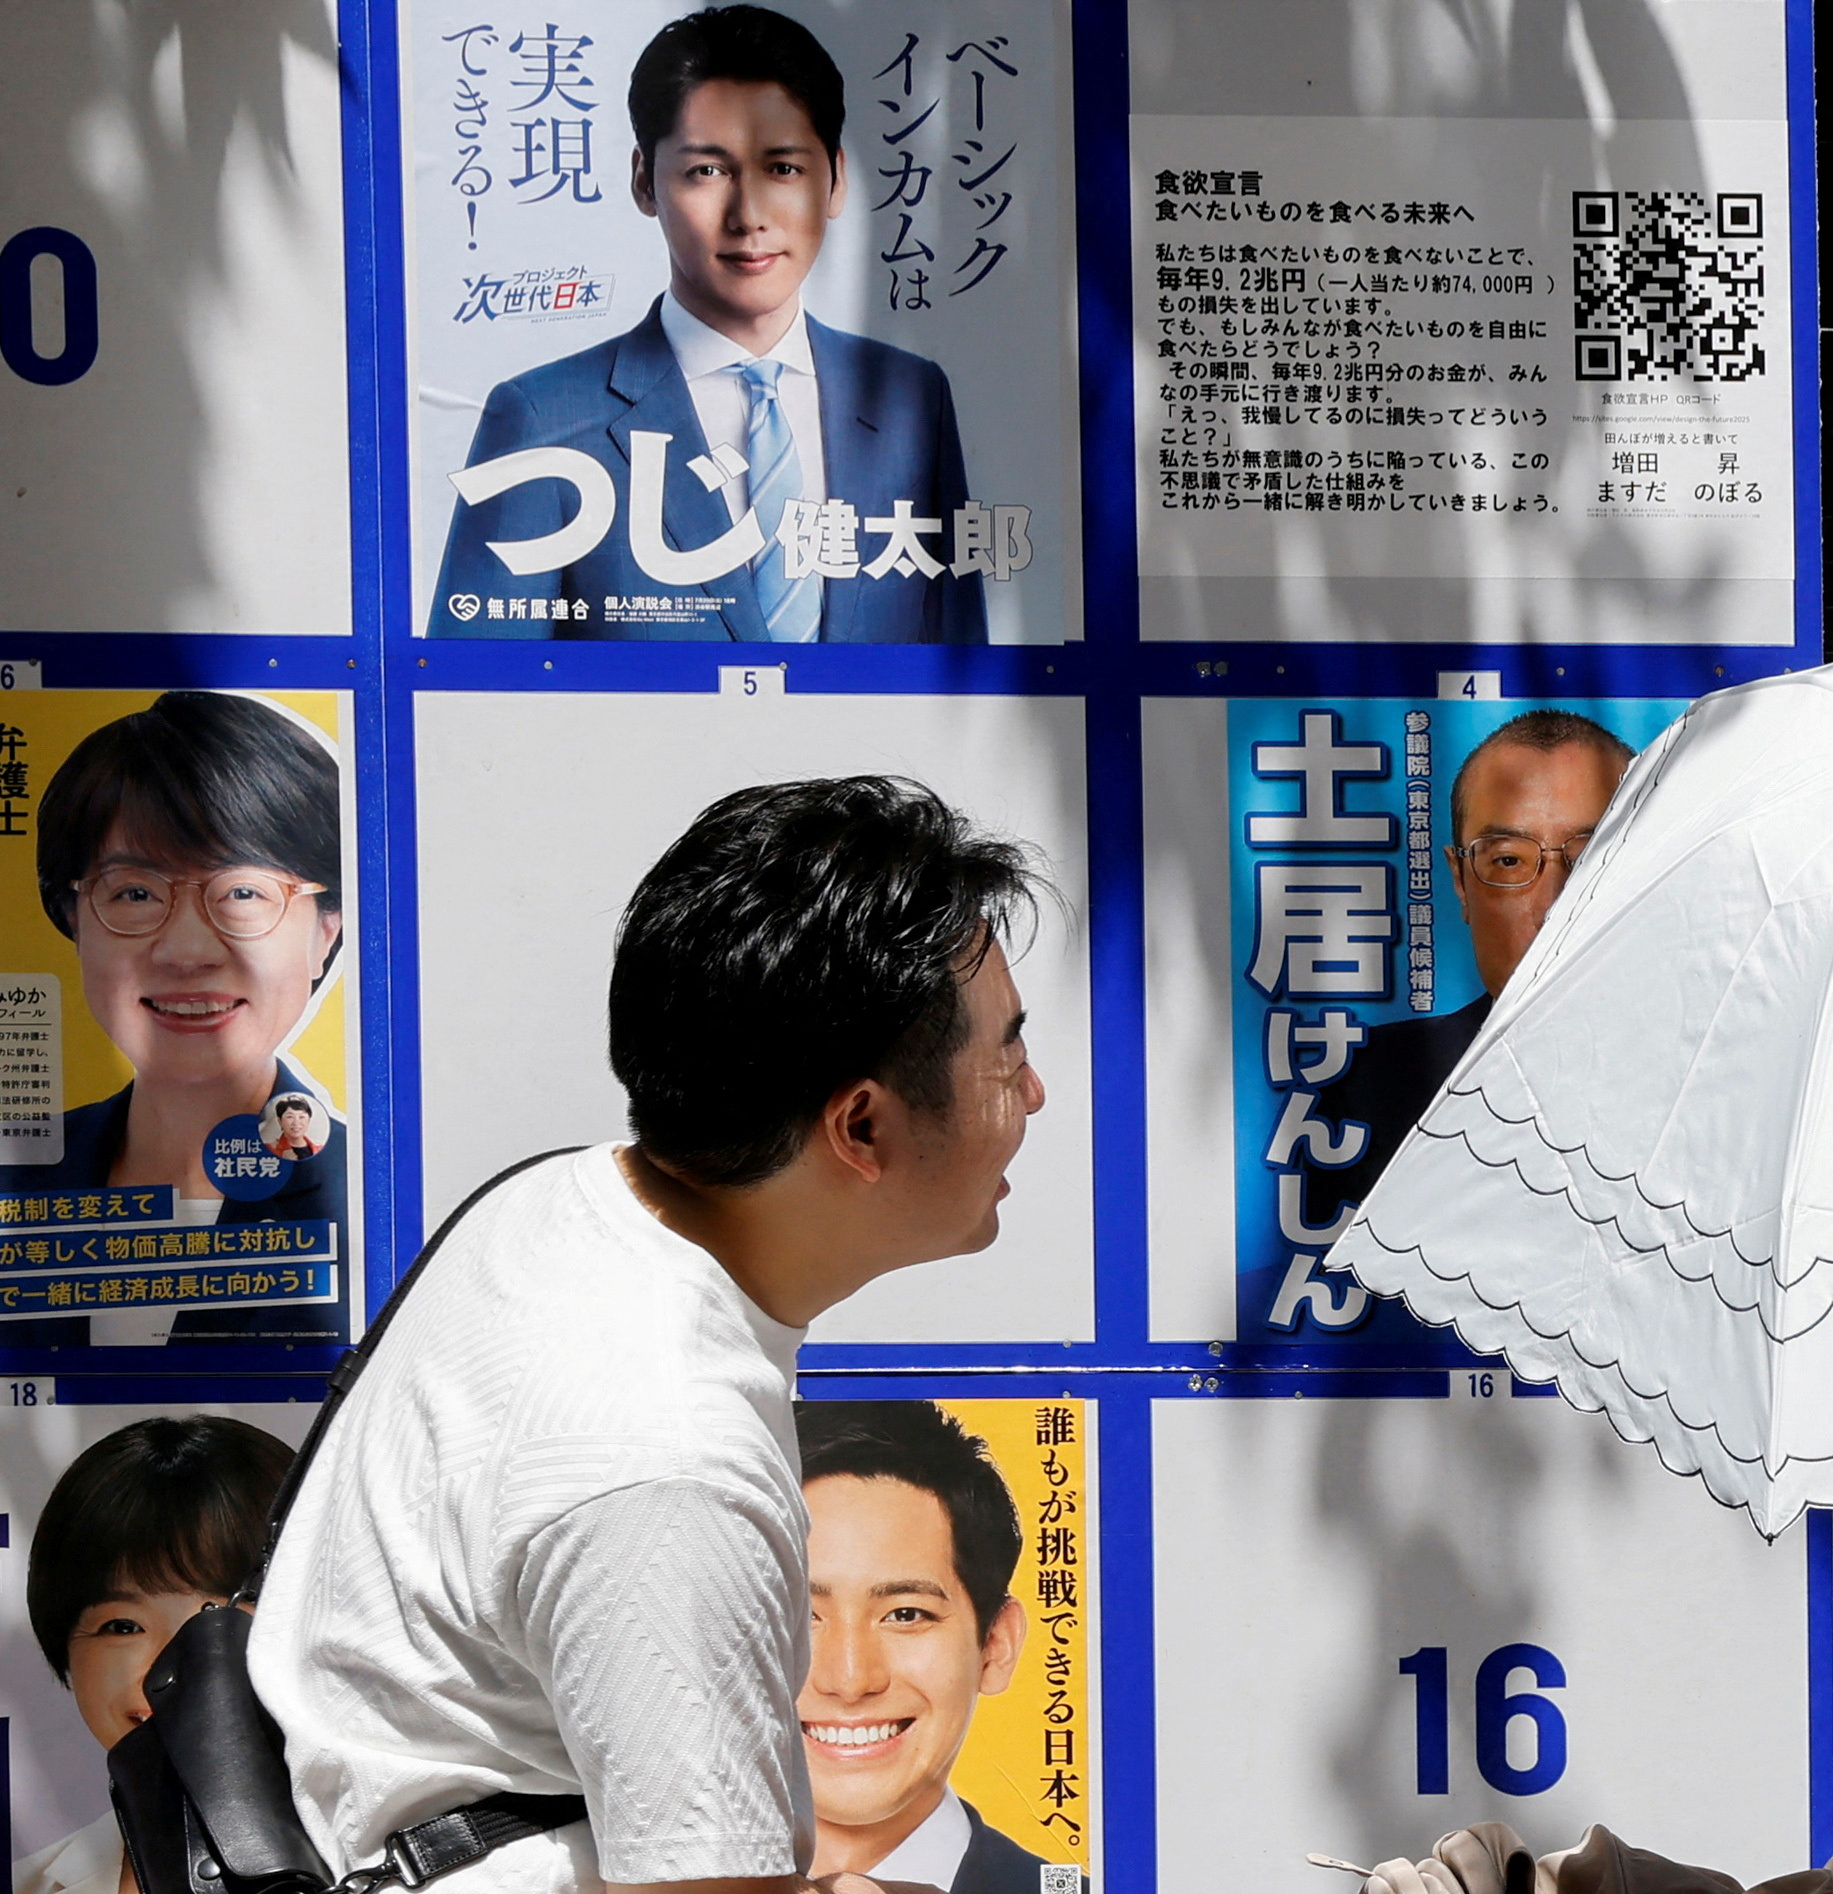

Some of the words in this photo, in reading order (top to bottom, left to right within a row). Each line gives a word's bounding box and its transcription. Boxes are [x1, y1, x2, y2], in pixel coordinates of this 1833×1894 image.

[505, 24, 602, 205] 実現
[441, 24, 499, 250] できる！
[870, 32, 939, 312] インカムは
[945, 36, 1019, 299] ベーシック
[1155, 170, 1263, 197] 食欲宣言
[1155, 200, 1475, 226] 食べたいものを食べる未来へ
[1156, 243, 1539, 266] 私たちは食べたいものを食べないことで、
[513, 265, 587, 284] プロジェクト
[452, 274, 601, 324] 次世代日本
[1158, 295, 1394, 316] もの損失を出しています。
[1158, 317, 1547, 339] でも、もしみんなが食べたいものを自由に
[1158, 339, 1381, 359] 食べたらどうでしょう？
[1160, 383, 1394, 405] なの手元に行き渡ります。
[1602, 393, 1668, 405] 食欲宣言HP
[1676, 393, 1722, 405] QRコード
[1168, 405, 1548, 427] 「えっ、我慢してるのに損失ってどういう
[1160, 427, 1232, 447] こと？」
[1604, 432, 1738, 445] 田んぼが増えると書いて
[1160, 450, 1549, 471] 私たちが無意識のうちに陥っている、この
[1612, 451, 1659, 474] 増田
[1717, 452, 1740, 475] 昇
[1160, 472, 1404, 492] 不思議で矛盾した仕組みを
[1598, 480, 1668, 503] ますだ
[1694, 481, 1762, 503] のぼる
[1160, 491, 1560, 514] これから一緒に解き明かしていきましょう。
[487, 598, 589, 620] 無所属連合
[604, 596, 672, 610] 個人演説会
[744, 672, 757, 695] 5
[1463, 675, 1477, 699] 4
[0, 723, 29, 836] 弁護士
[1405, 711, 1433, 1012] 参議院（東京都選出）議員候補者
[1244, 708, 1400, 1334] 土居けんしん
[214, 1137, 262, 1155] 比例は
[214, 1155, 281, 1180] 社民党
[0, 1193, 156, 1223] 税制を変えて
[0, 1268, 315, 1308] で一緒に経済成長に向かう！
[10, 1382, 37, 1406] 18
[1468, 1374, 1494, 1398] 16
[1035, 1406, 1082, 1849] 誰もが挑戦できる日本へ。
[1399, 1643, 1567, 1796] 16
